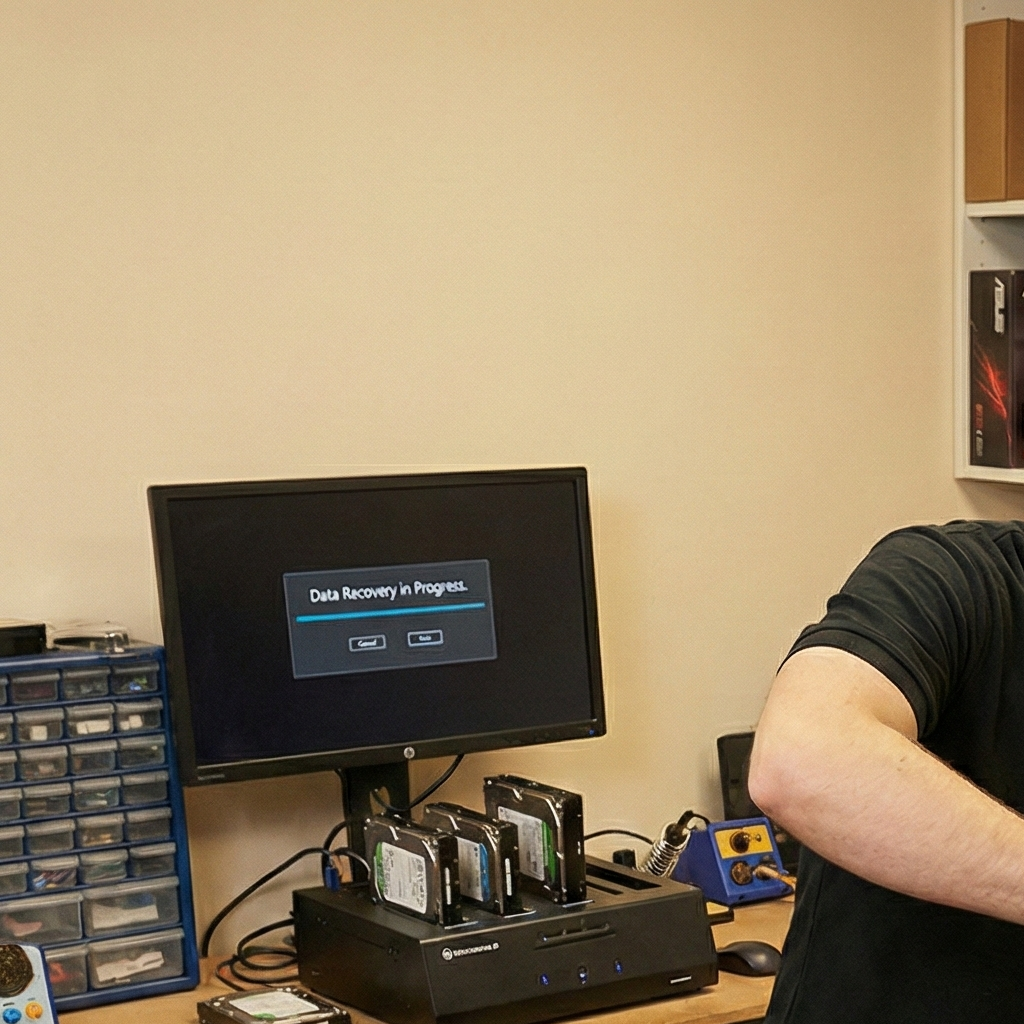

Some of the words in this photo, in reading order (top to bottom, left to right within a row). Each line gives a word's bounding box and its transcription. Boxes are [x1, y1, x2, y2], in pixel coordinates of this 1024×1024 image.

[310, 587, 340, 603] Data
[342, 582, 397, 601] Recovery
[400, 581, 412, 595] in
